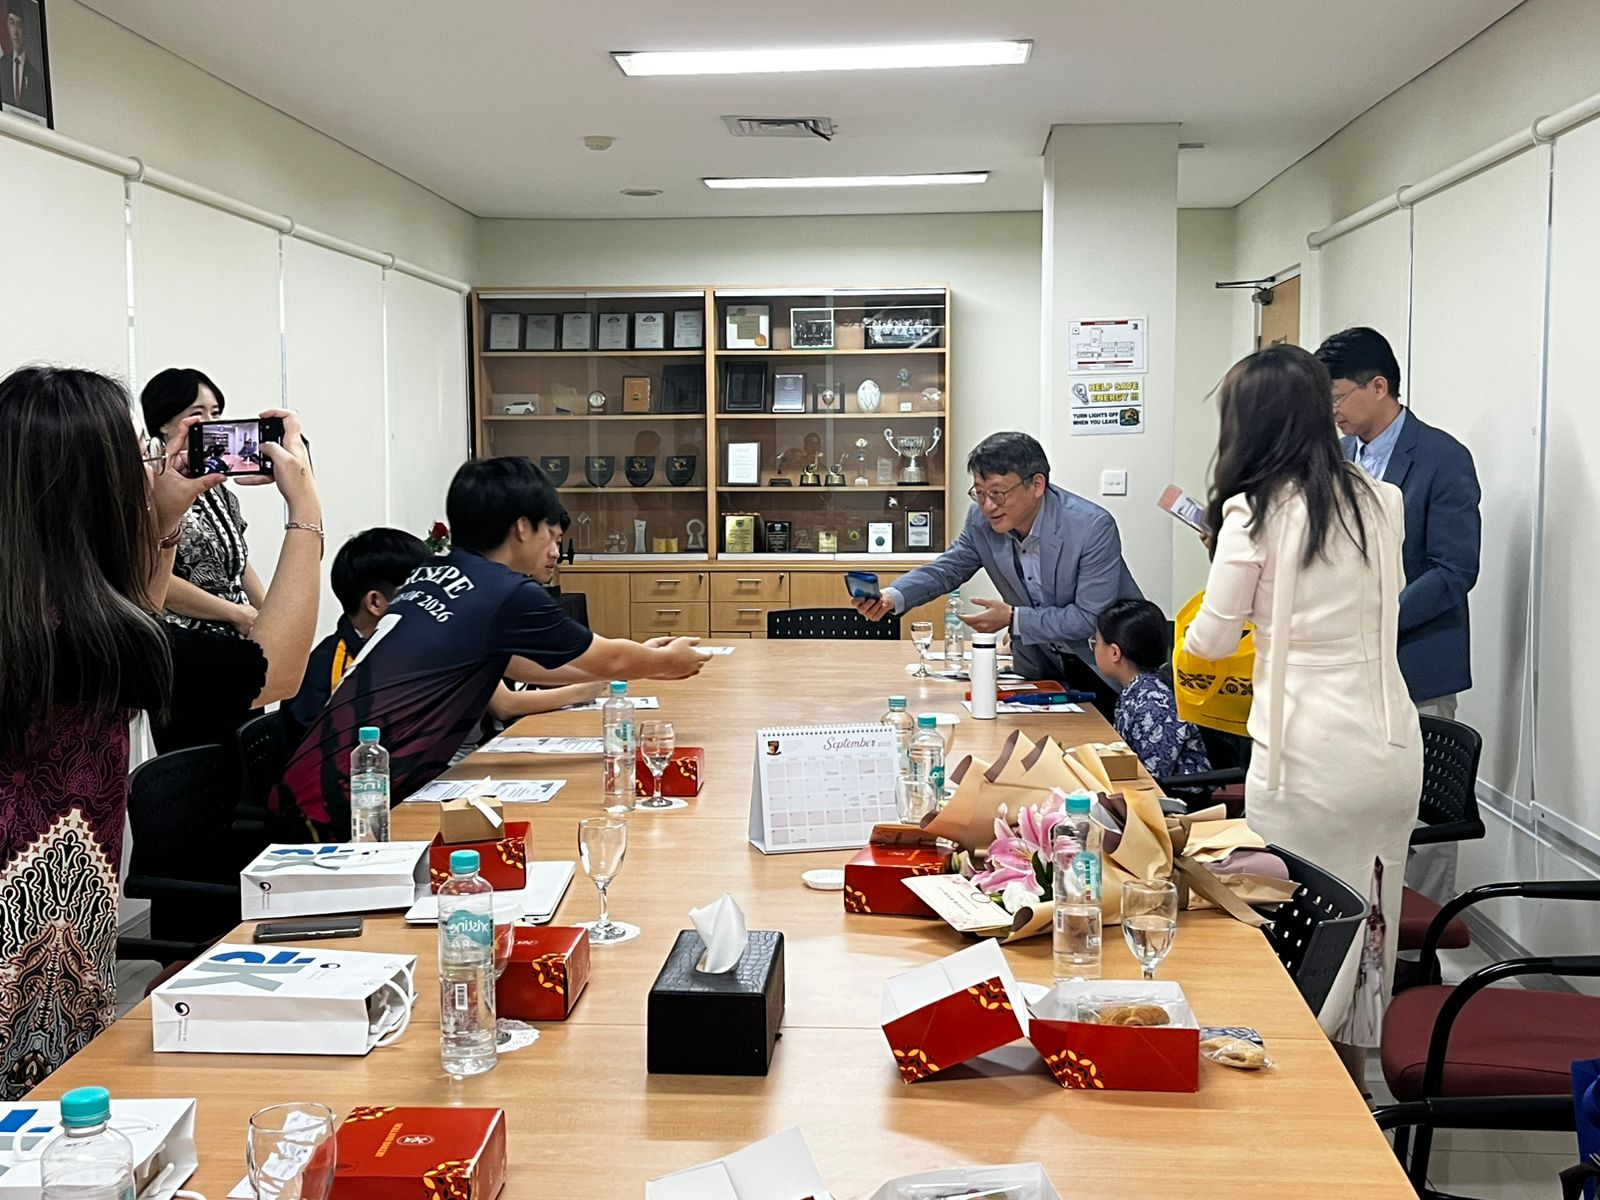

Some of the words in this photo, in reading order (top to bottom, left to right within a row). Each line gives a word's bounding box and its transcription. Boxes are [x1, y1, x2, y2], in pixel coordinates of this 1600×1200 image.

[1088, 383, 1112, 392] HELP
[1114, 382, 1139, 391] SAVE
[1091, 393, 1129, 402] ENERGY
[417, 594, 455, 623] 2026
[823, 736, 876, 753] September
